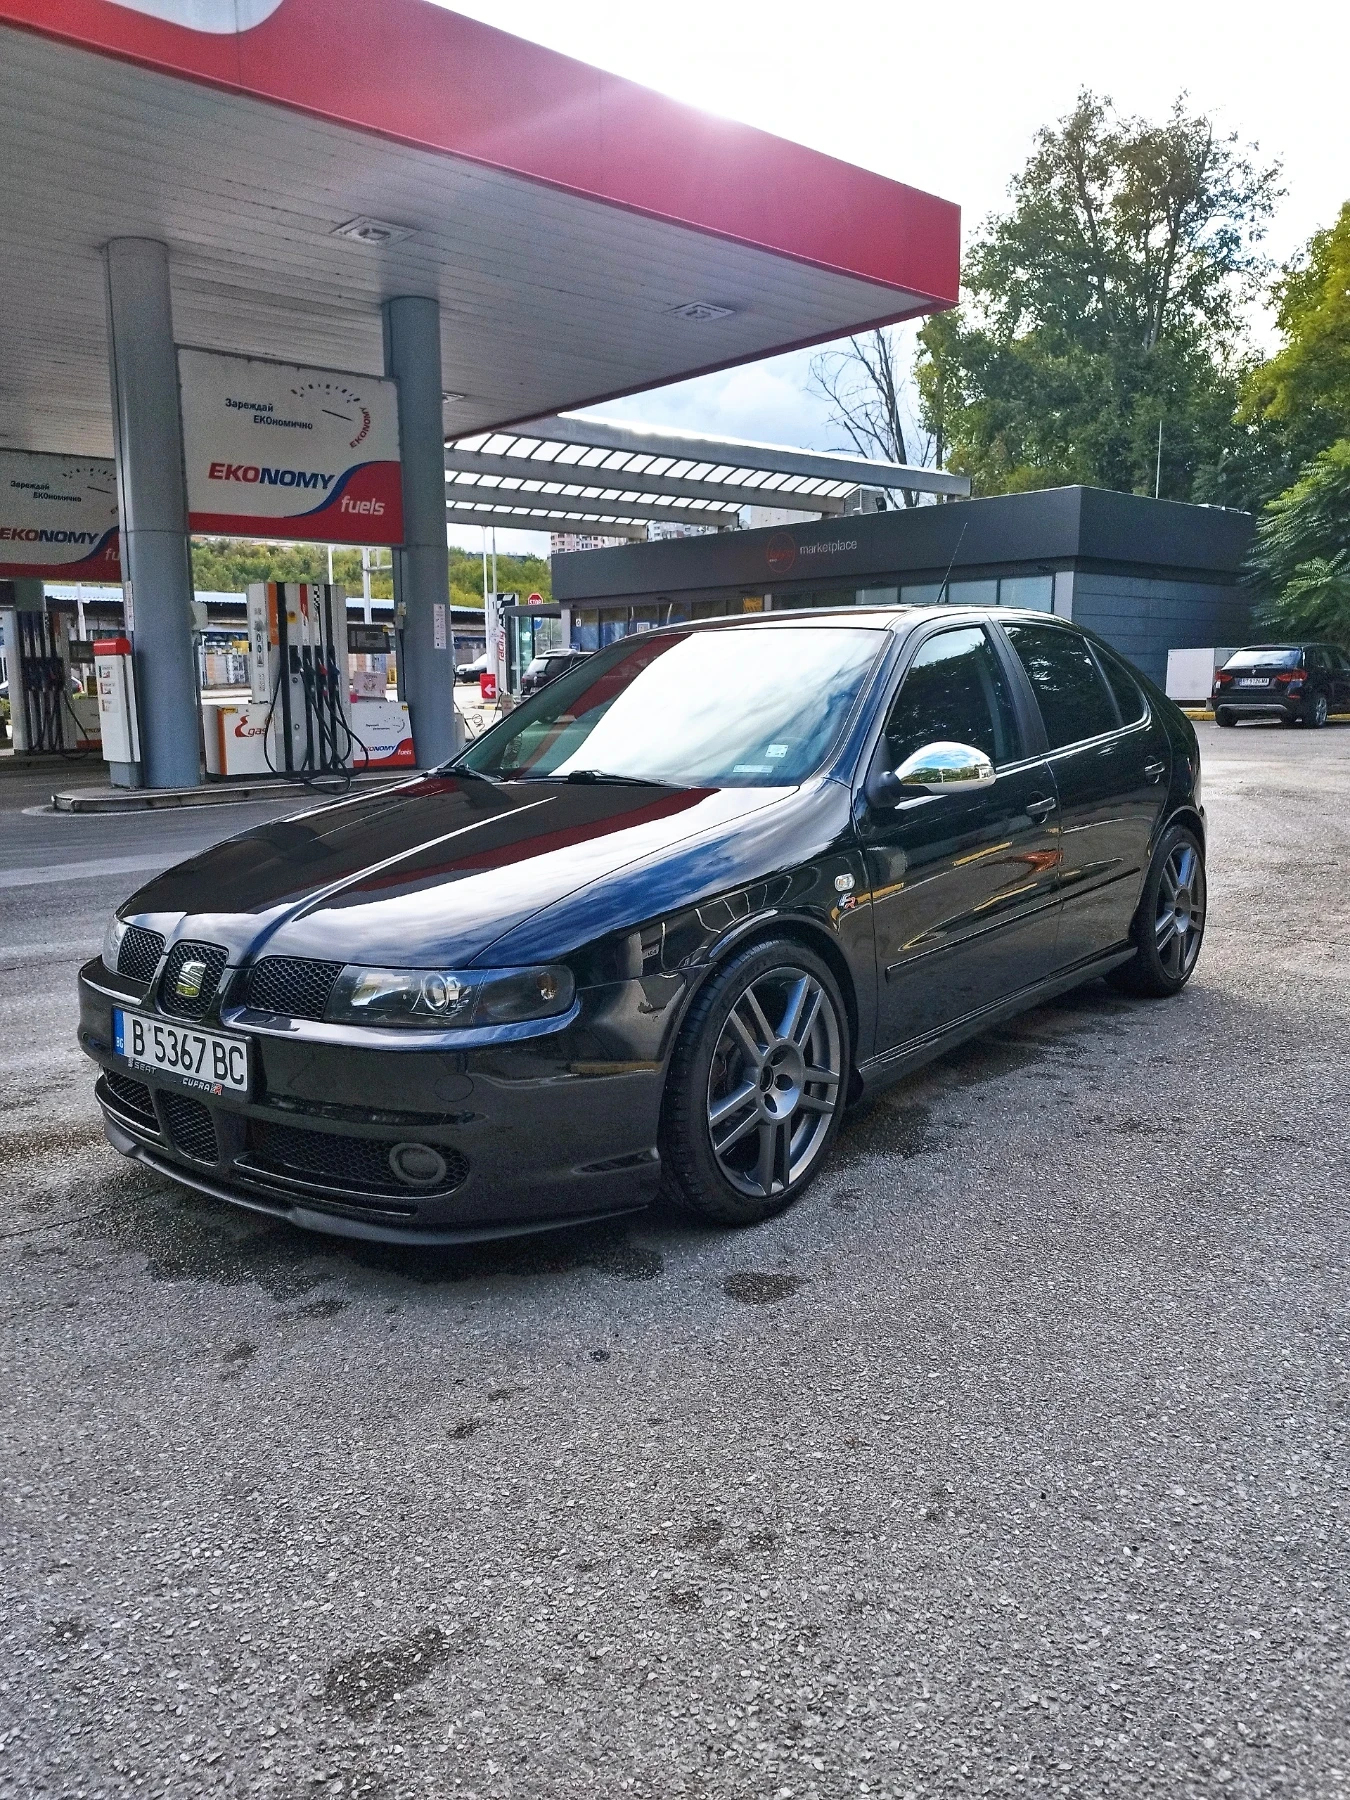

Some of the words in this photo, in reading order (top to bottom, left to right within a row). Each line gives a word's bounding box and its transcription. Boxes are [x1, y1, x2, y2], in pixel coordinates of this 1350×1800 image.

[225, 398, 274, 413] Зареждай
[253, 415, 313, 430] ЕКОномично
[350, 406, 371, 448] EKONOMY
[208, 462, 336, 490] EKONOMY
[10, 480, 50, 491] Зареждай
[341, 496, 385, 516] fuels
[0, 527, 99, 545] EKONOMY
[800, 540, 857, 555] marketplace
[116, 1036, 124, 1049] BG
[132, 1018, 145, 1057] B
[153, 1025, 207, 1074] 5367
[212, 1040, 245, 1086] BC
[134, 1062, 157, 1075] SEAT
